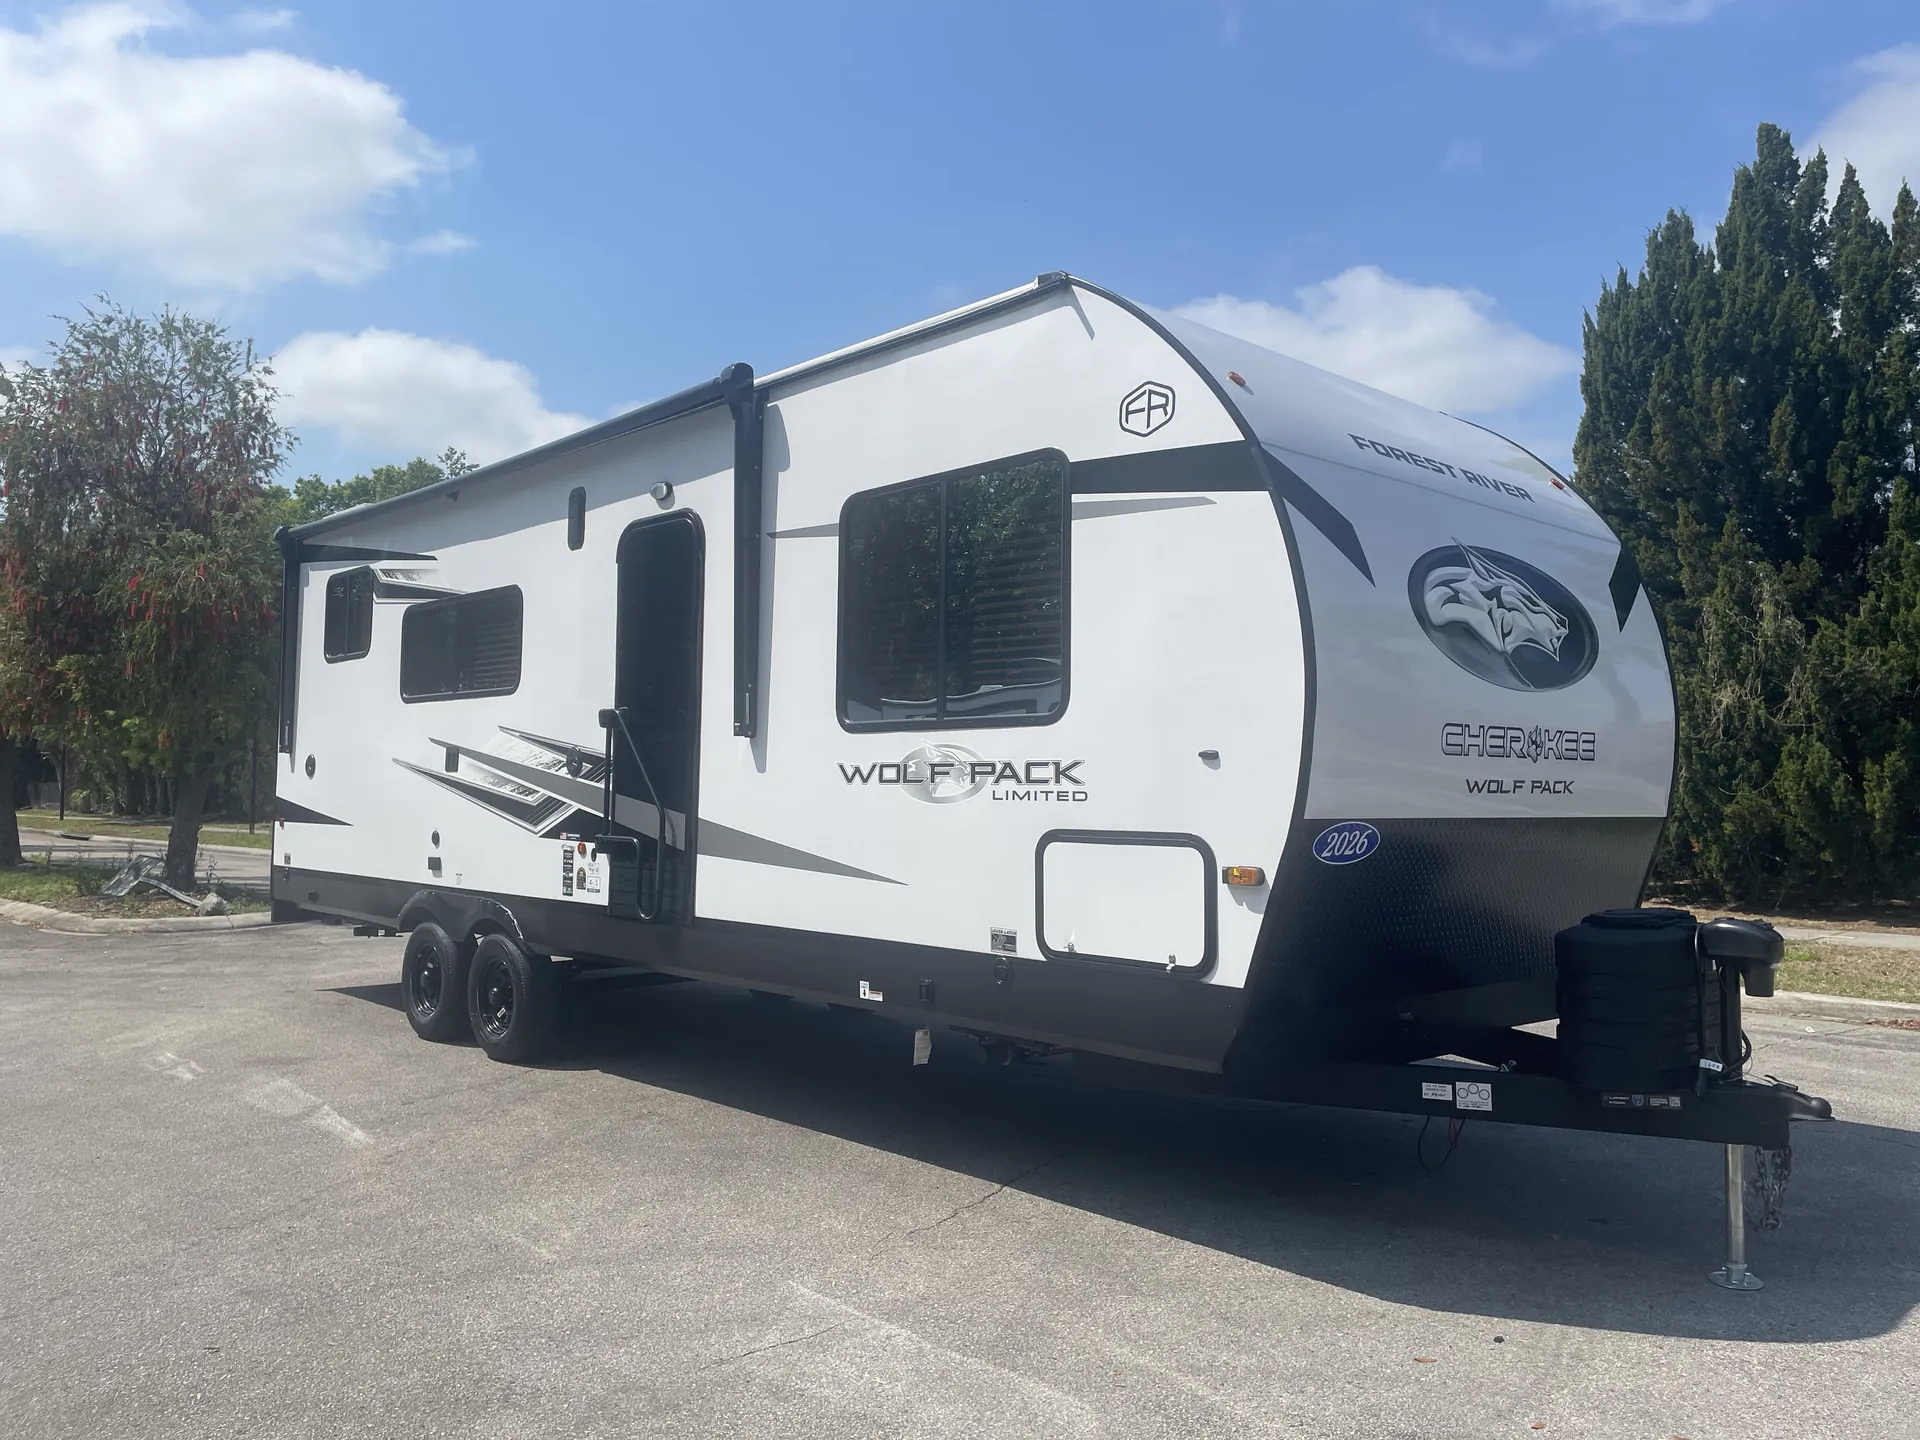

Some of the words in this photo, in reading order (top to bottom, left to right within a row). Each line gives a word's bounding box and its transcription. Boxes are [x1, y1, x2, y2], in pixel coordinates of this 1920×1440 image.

[1347, 432, 1457, 479] FOREST
[1457, 467, 1536, 504] RIVER
[836, 761, 955, 786] WOLF
[962, 759, 1086, 787] PACK
[1465, 778, 1526, 795] WOLF
[1530, 779, 1576, 795] PACK
[991, 789, 1089, 803] LIMITED
[1321, 829, 1373, 858] 2026
